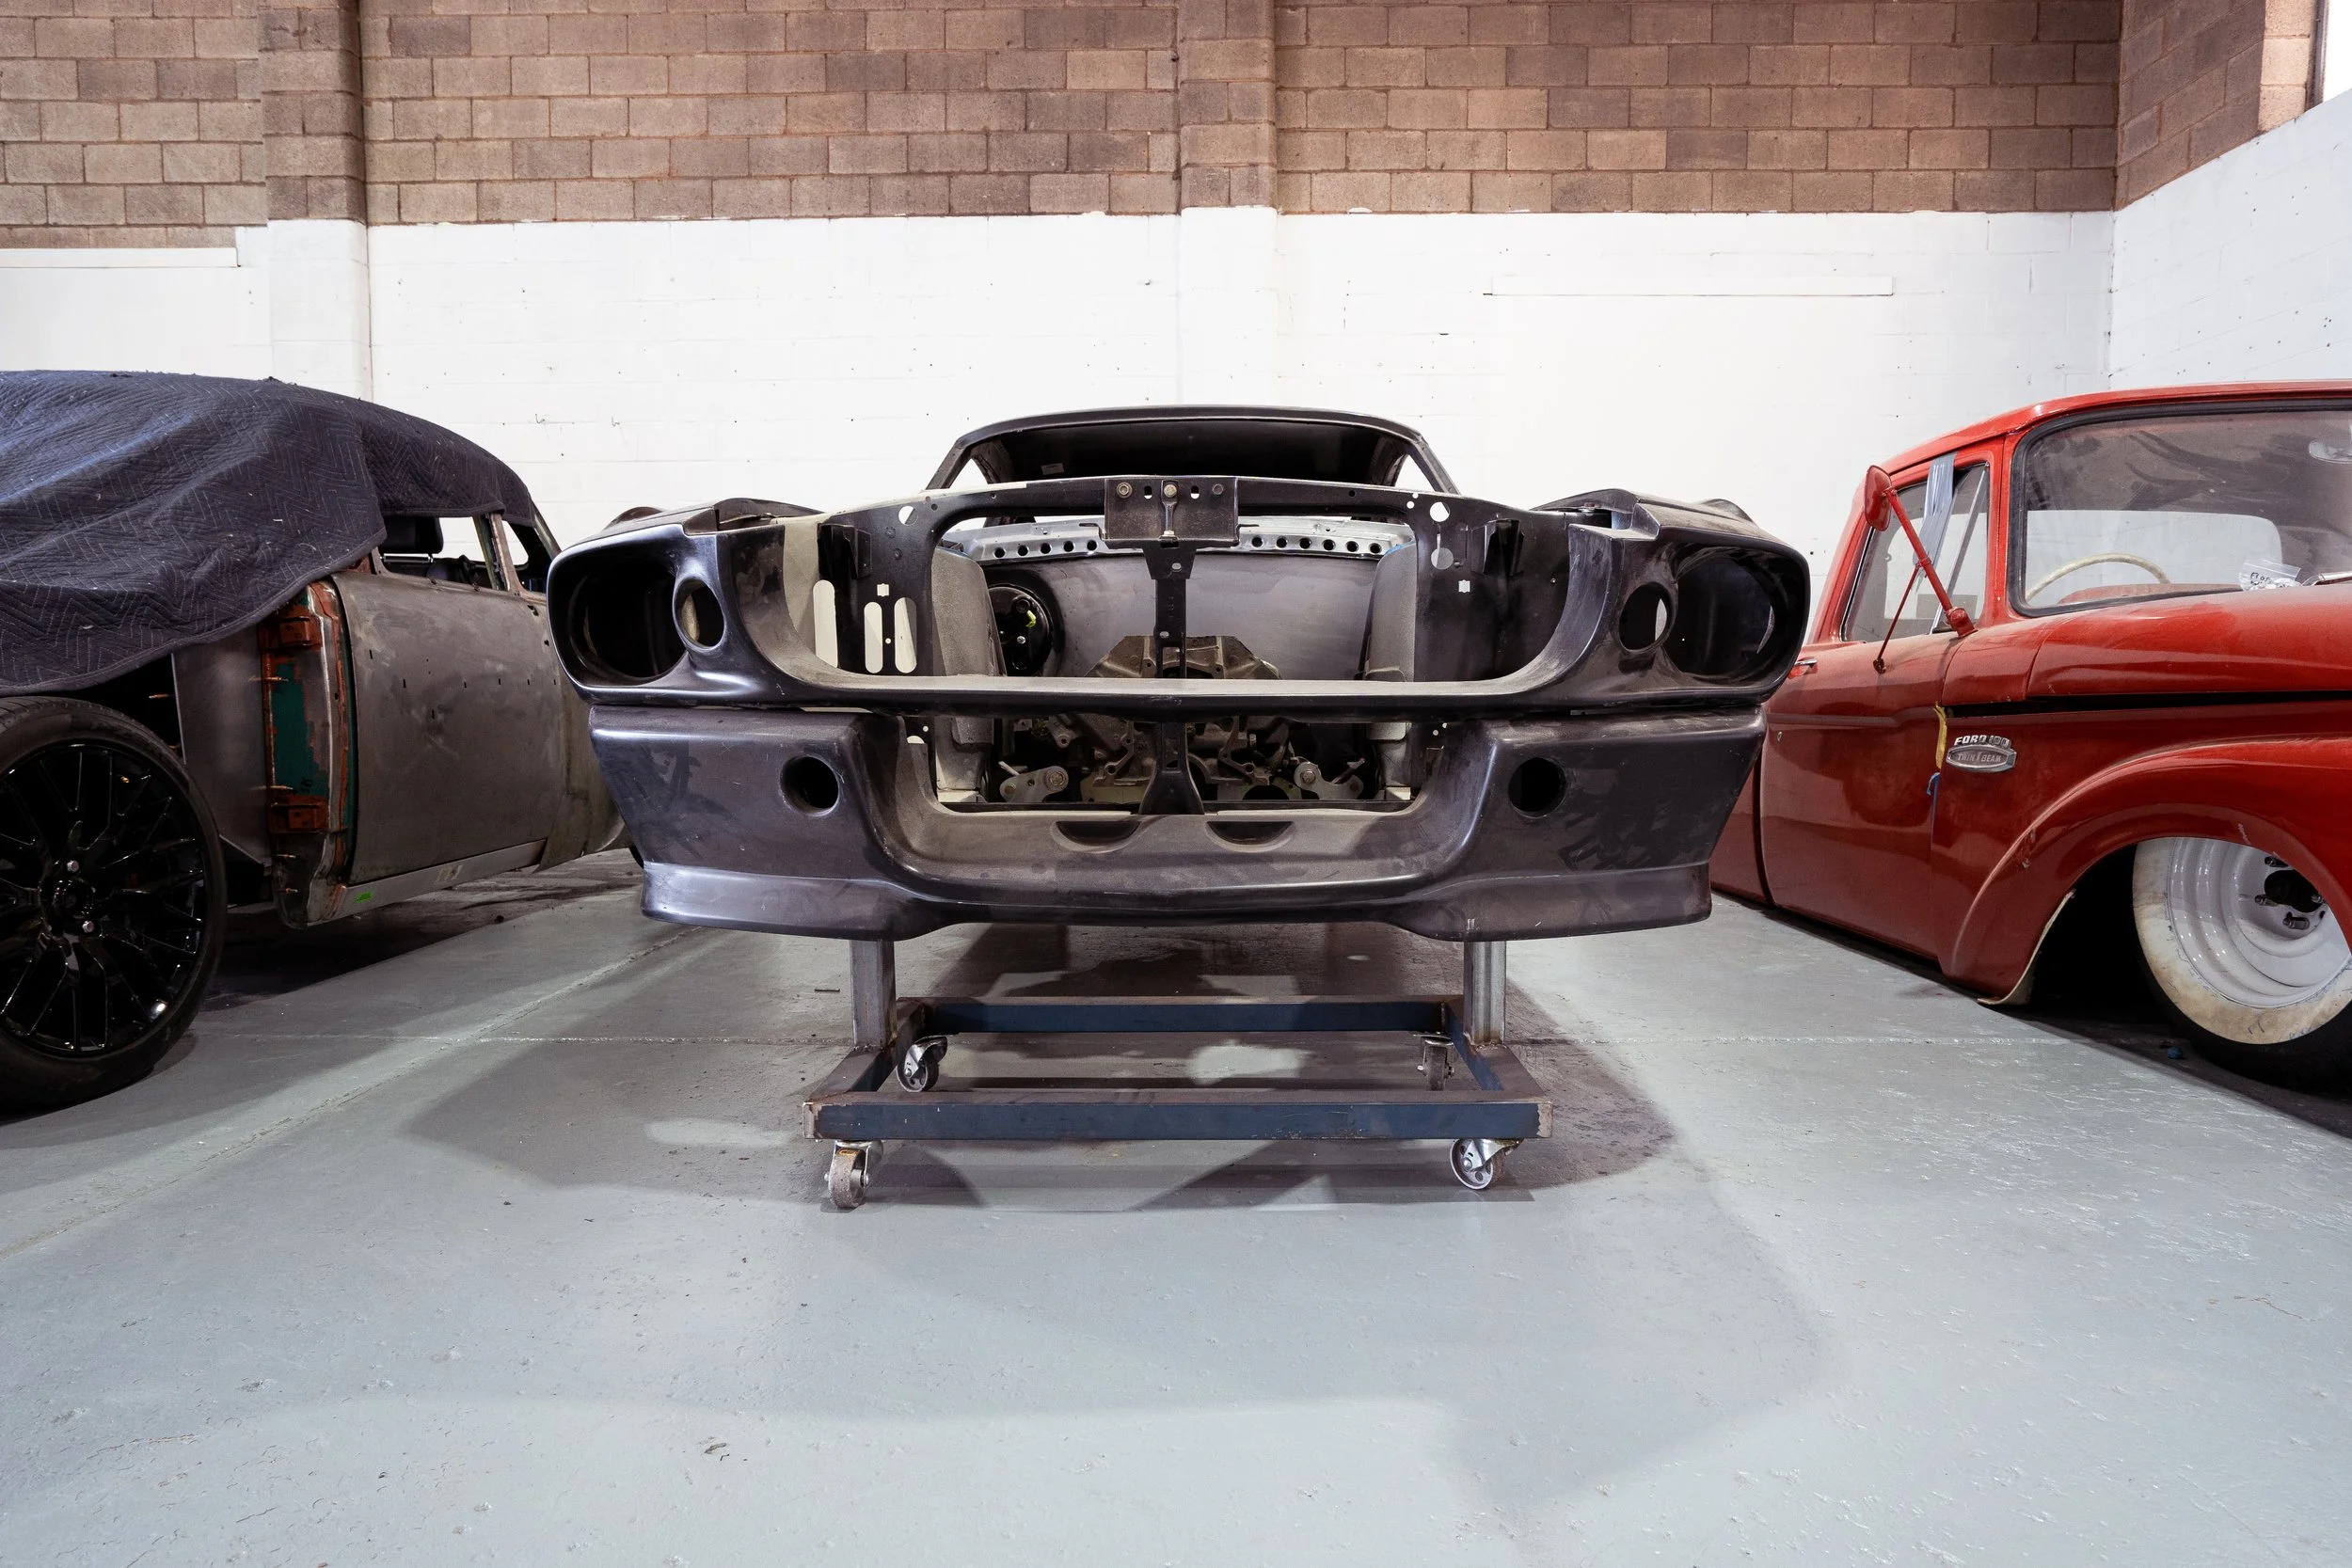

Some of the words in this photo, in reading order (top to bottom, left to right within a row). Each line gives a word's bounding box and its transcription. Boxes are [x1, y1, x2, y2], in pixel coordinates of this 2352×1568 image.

[1954, 735, 1987, 745] FORD
[1989, 736, 2010, 747] 100
[1957, 752, 1976, 762] TWIN
[1981, 753, 2001, 762] BEAM
